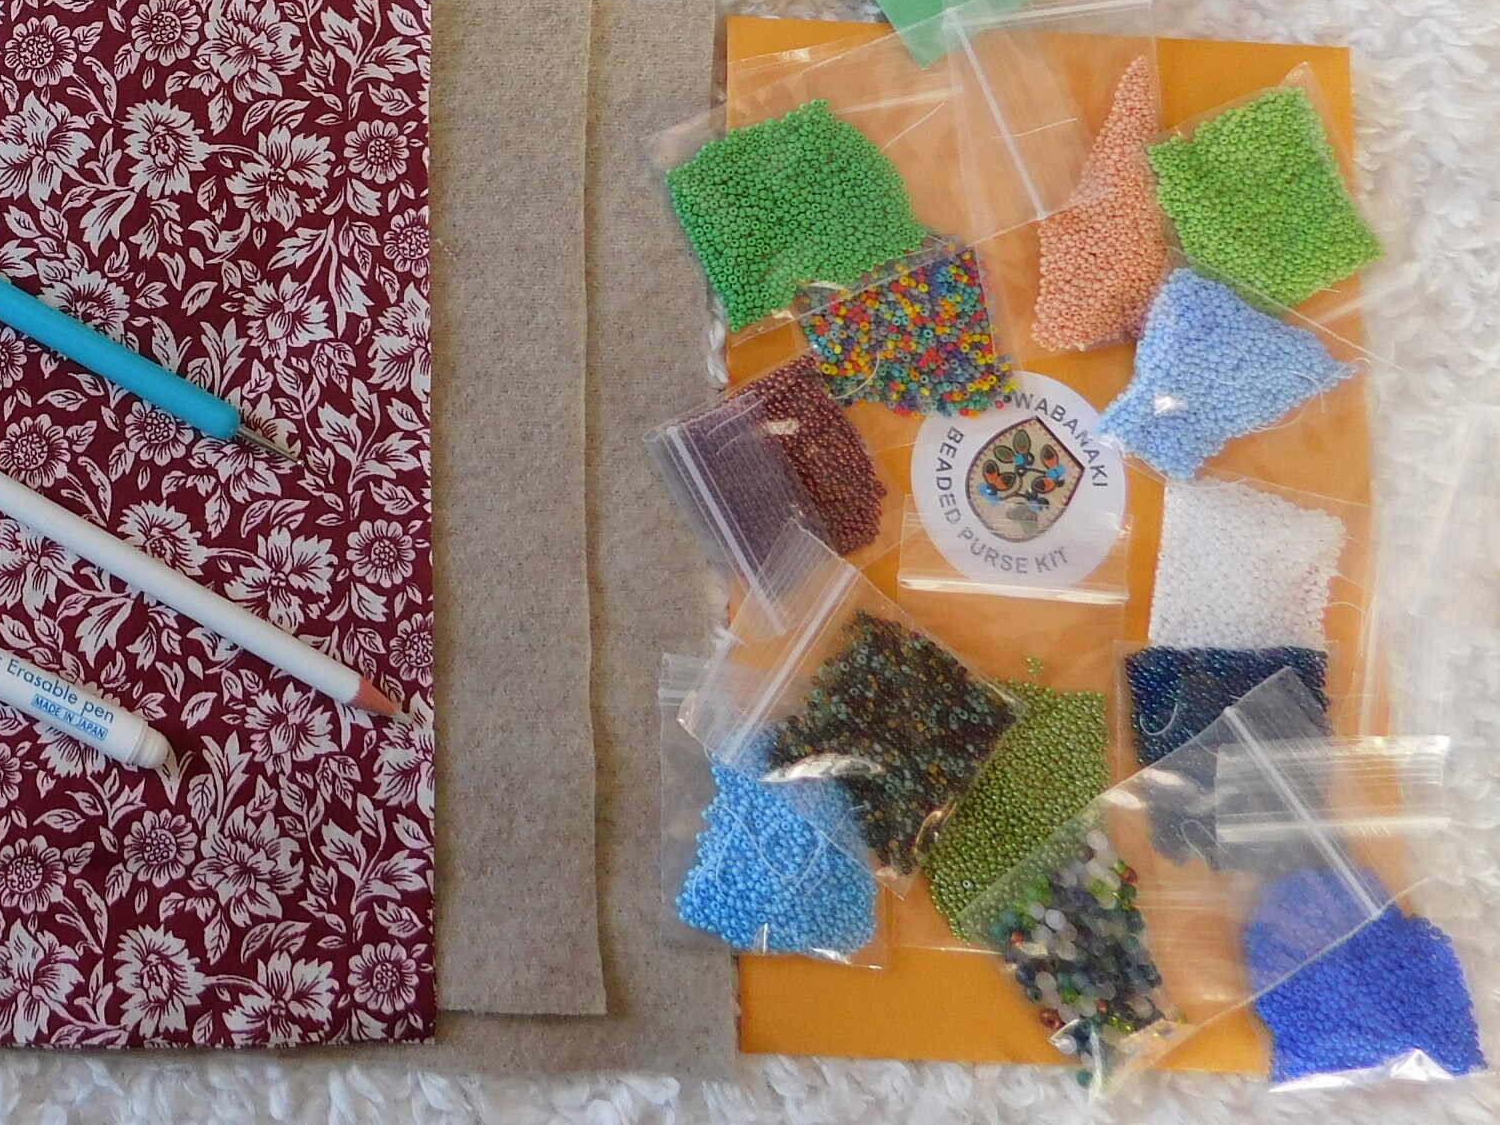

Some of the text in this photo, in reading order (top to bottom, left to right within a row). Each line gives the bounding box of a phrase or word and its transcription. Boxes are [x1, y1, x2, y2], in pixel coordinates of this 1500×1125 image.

[1012, 391, 1108, 487] WABANAKI
[935, 425, 1069, 574] BEADED PURSE KIT
[6, 658, 78, 704] Erasable
[81, 700, 114, 723] pen
[34, 697, 106, 739] MADE IN JAPAN
